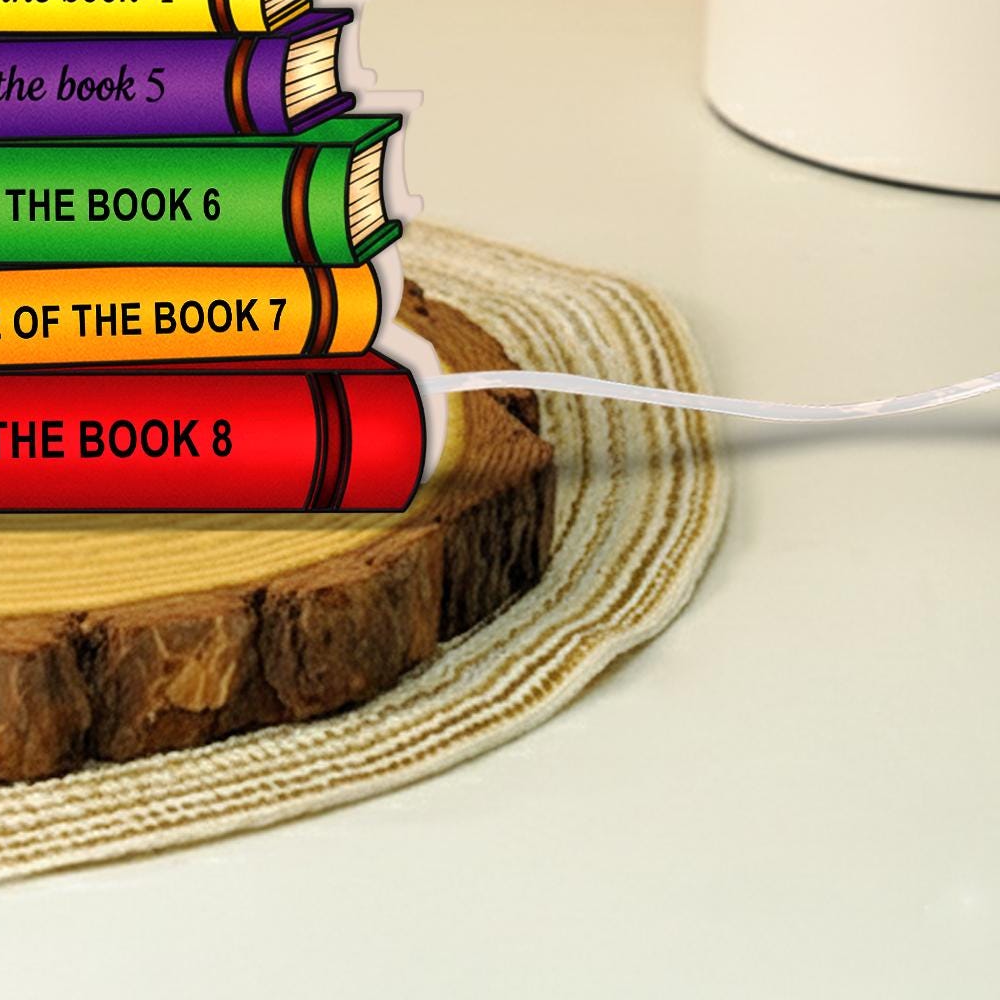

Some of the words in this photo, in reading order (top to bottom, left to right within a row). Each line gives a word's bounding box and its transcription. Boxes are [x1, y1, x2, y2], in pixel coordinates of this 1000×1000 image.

[57, 64, 136, 102] book
[146, 67, 165, 103] 5
[5, 188, 75, 222] THE
[88, 187, 193, 222] BOOK
[203, 187, 221, 221] 6
[13, 305, 60, 340] OF
[71, 302, 142, 337] THE
[154, 298, 260, 335] BOOK
[269, 298, 287, 331] 7
[79, 419, 199, 458] BOOK
[212, 419, 233, 457] 8
